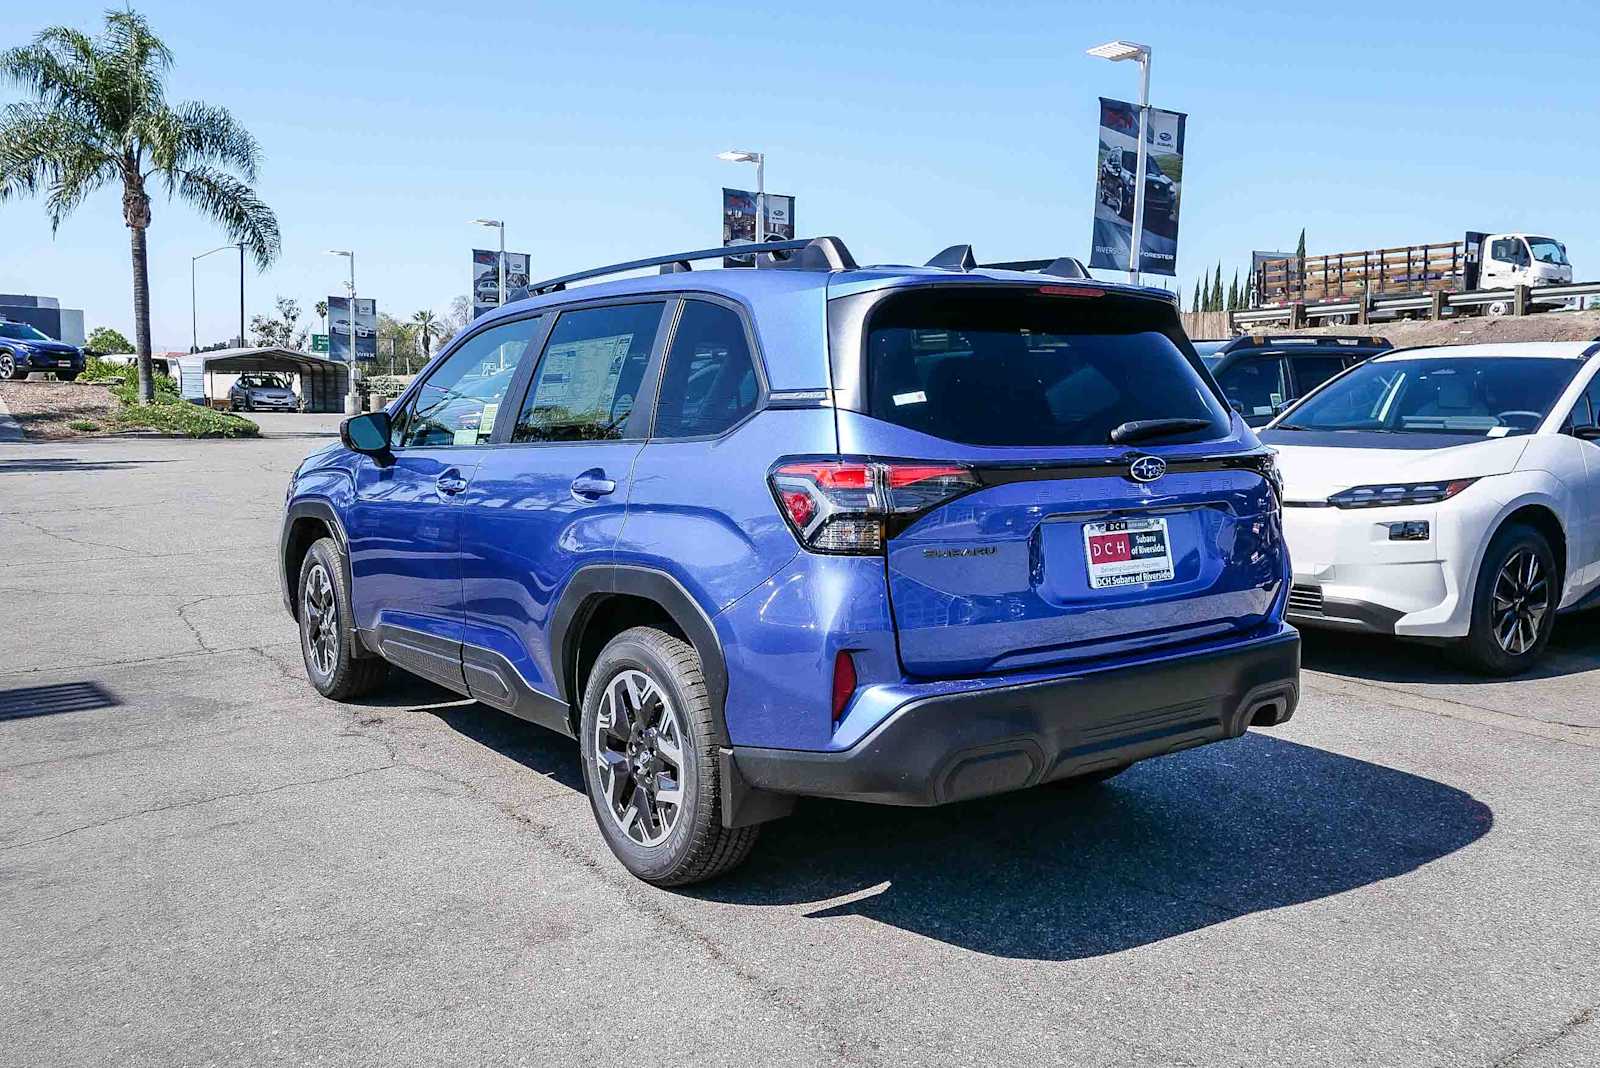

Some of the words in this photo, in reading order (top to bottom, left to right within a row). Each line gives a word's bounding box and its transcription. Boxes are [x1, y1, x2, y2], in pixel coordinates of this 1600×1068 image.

[1110, 522, 1126, 530] DCH
[1135, 534, 1157, 544] Subaru
[1092, 540, 1126, 556] DCH
[1139, 544, 1165, 554] Riverside
[1096, 577, 1112, 586] DCH
[1112, 574, 1136, 585] Subaru
